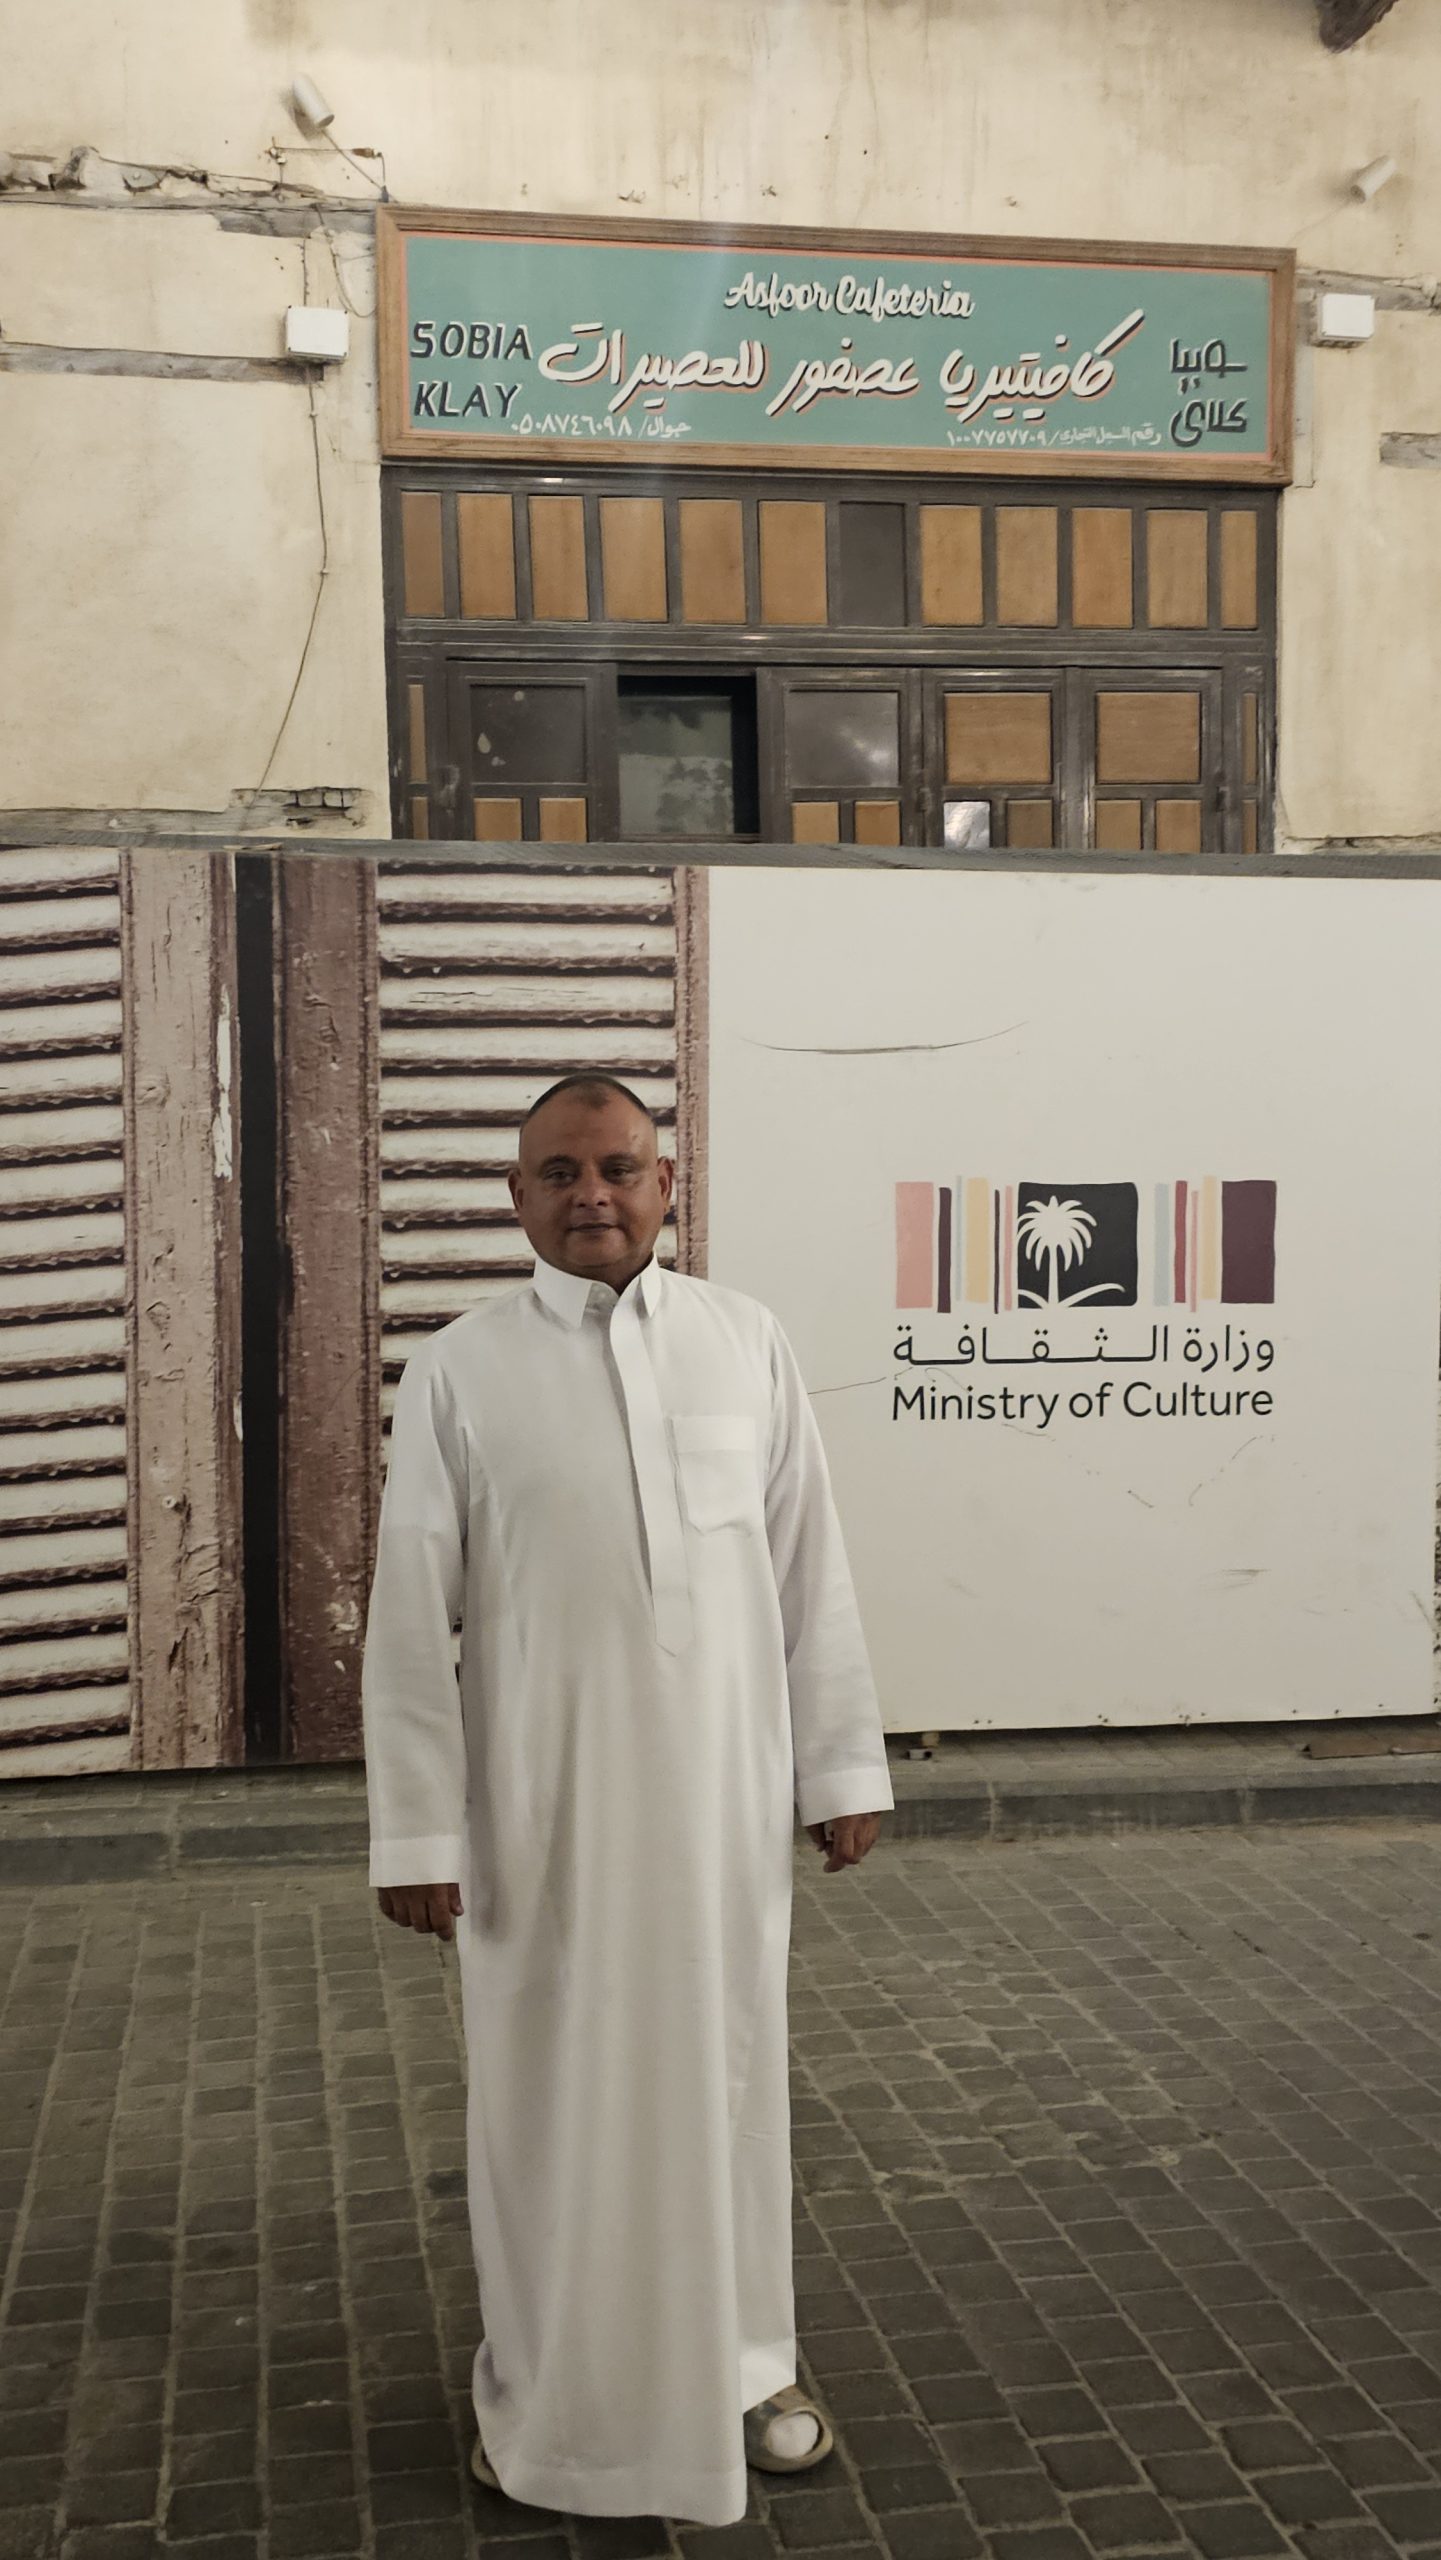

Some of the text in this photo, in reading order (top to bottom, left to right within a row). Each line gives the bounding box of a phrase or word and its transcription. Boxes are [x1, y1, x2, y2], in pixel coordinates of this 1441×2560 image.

[724, 271, 976, 323] Asfoor Cafeteria
[410, 321, 533, 361] SOBIA
[537, 322, 768, 414] للعصيرات
[764, 337, 922, 417] عصفور
[414, 380, 523, 418] KLAY
[1131, 422, 1162, 447] رقم
[893, 1323, 1275, 1373] وزارة الثقافة
[892, 1381, 1274, 1429] Ministry of Culture
